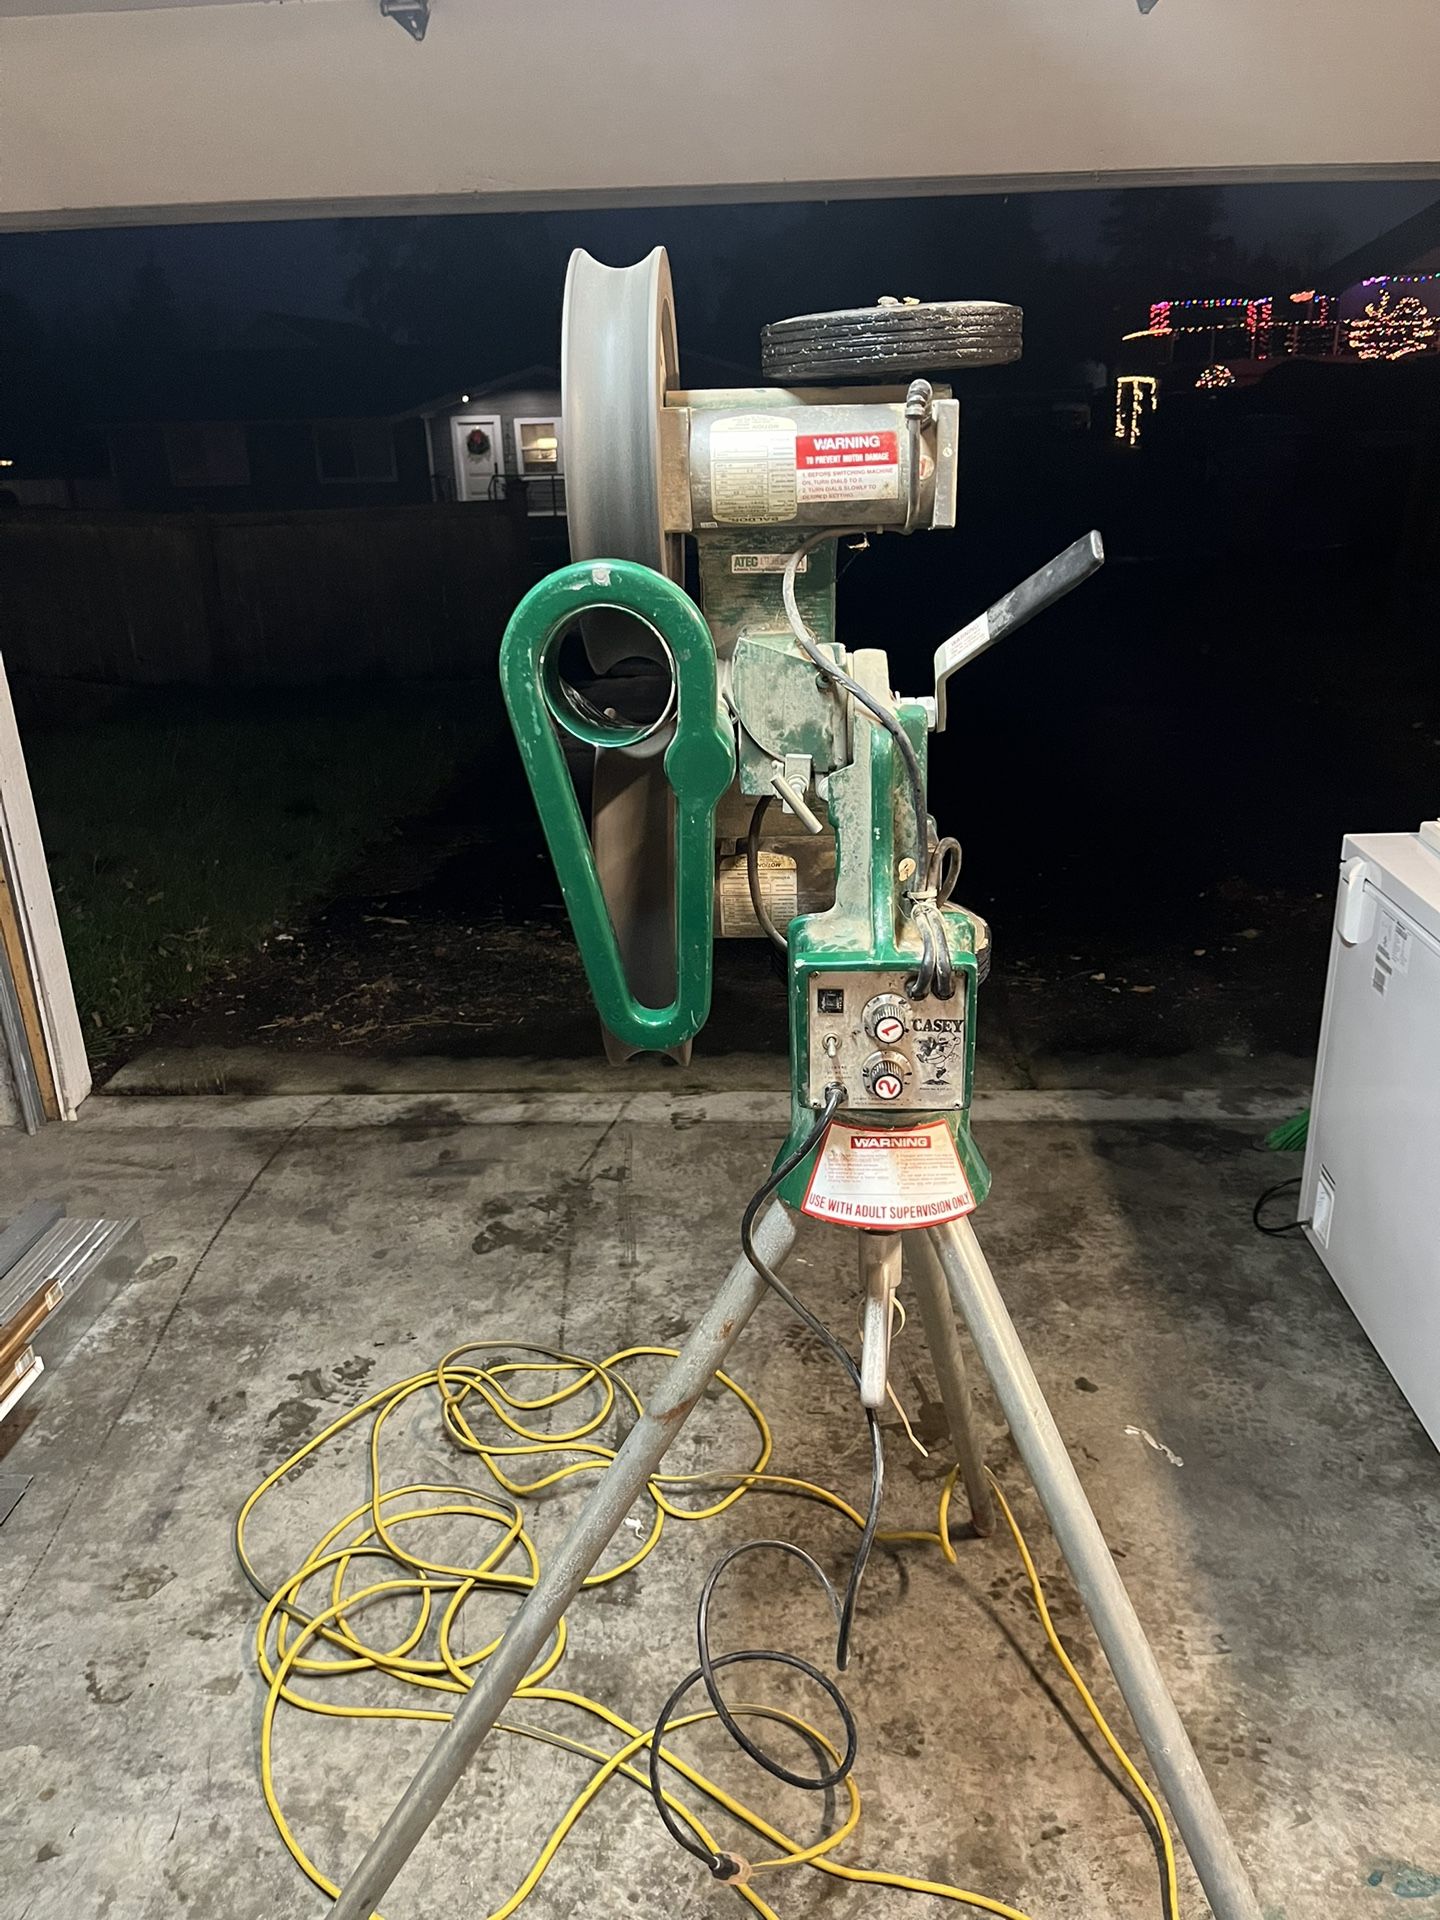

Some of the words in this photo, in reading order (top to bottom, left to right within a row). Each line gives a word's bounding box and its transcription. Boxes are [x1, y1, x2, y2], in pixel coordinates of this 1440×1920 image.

[813, 435, 880, 451] WARNING
[806, 456, 814, 465] TO
[815, 455, 841, 464] PREVENT
[842, 453, 863, 463] MOTOR
[864, 452, 889, 461] DAMAGE
[734, 556, 758, 567] ATEC
[881, 1023, 899, 1036] 1
[912, 1018, 964, 1032] CASEY
[878, 1079, 898, 1094] 2
[854, 1137, 928, 1148] WARNING
[808, 1193, 825, 1209] USE
[828, 1199, 852, 1216] WITH
[854, 1204, 887, 1219] ADULT
[890, 1200, 952, 1219] SUPERVISION
[952, 1192, 970, 1209] ONLY
